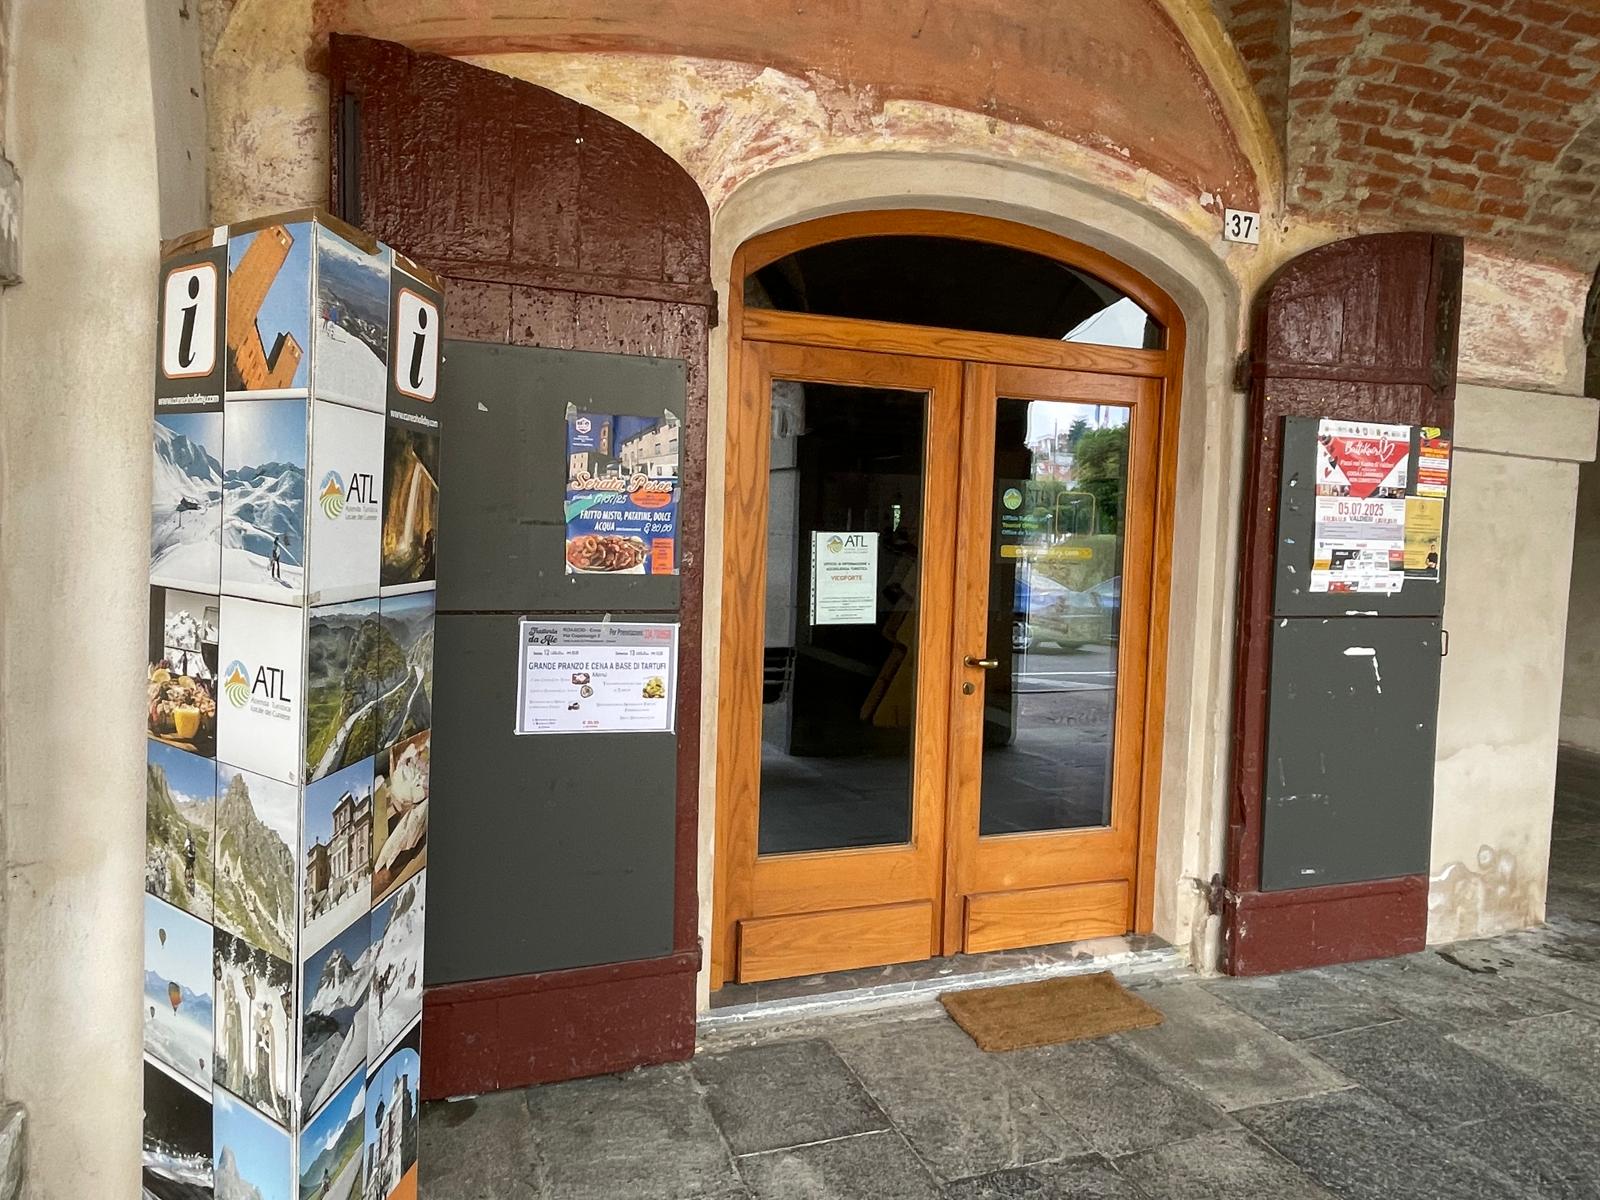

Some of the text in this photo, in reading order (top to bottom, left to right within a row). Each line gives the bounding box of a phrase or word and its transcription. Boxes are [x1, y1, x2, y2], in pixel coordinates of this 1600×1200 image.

[1231, 214, 1254, 239] 37
[178, 275, 200, 368] i
[408, 307, 428, 389] i
[346, 473, 378, 504] ATL
[571, 471, 673, 493] Serata Pesce
[580, 510, 672, 522] FRITTO MISTO, PATATINE, DOLCE
[1338, 502, 1384, 516] 05.07.2025
[594, 521, 615, 531] ACQUA
[844, 534, 868, 548] ATL
[528, 635, 540, 644] da
[528, 662, 557, 670] GRANDE
[557, 662, 585, 670] PRANZO
[585, 662, 590, 670] E
[591, 662, 608, 670] CENA
[615, 662, 632, 670] BASE
[633, 662, 640, 670] DI
[641, 662, 667, 670] TARTUFI
[251, 665, 292, 702] ATL
